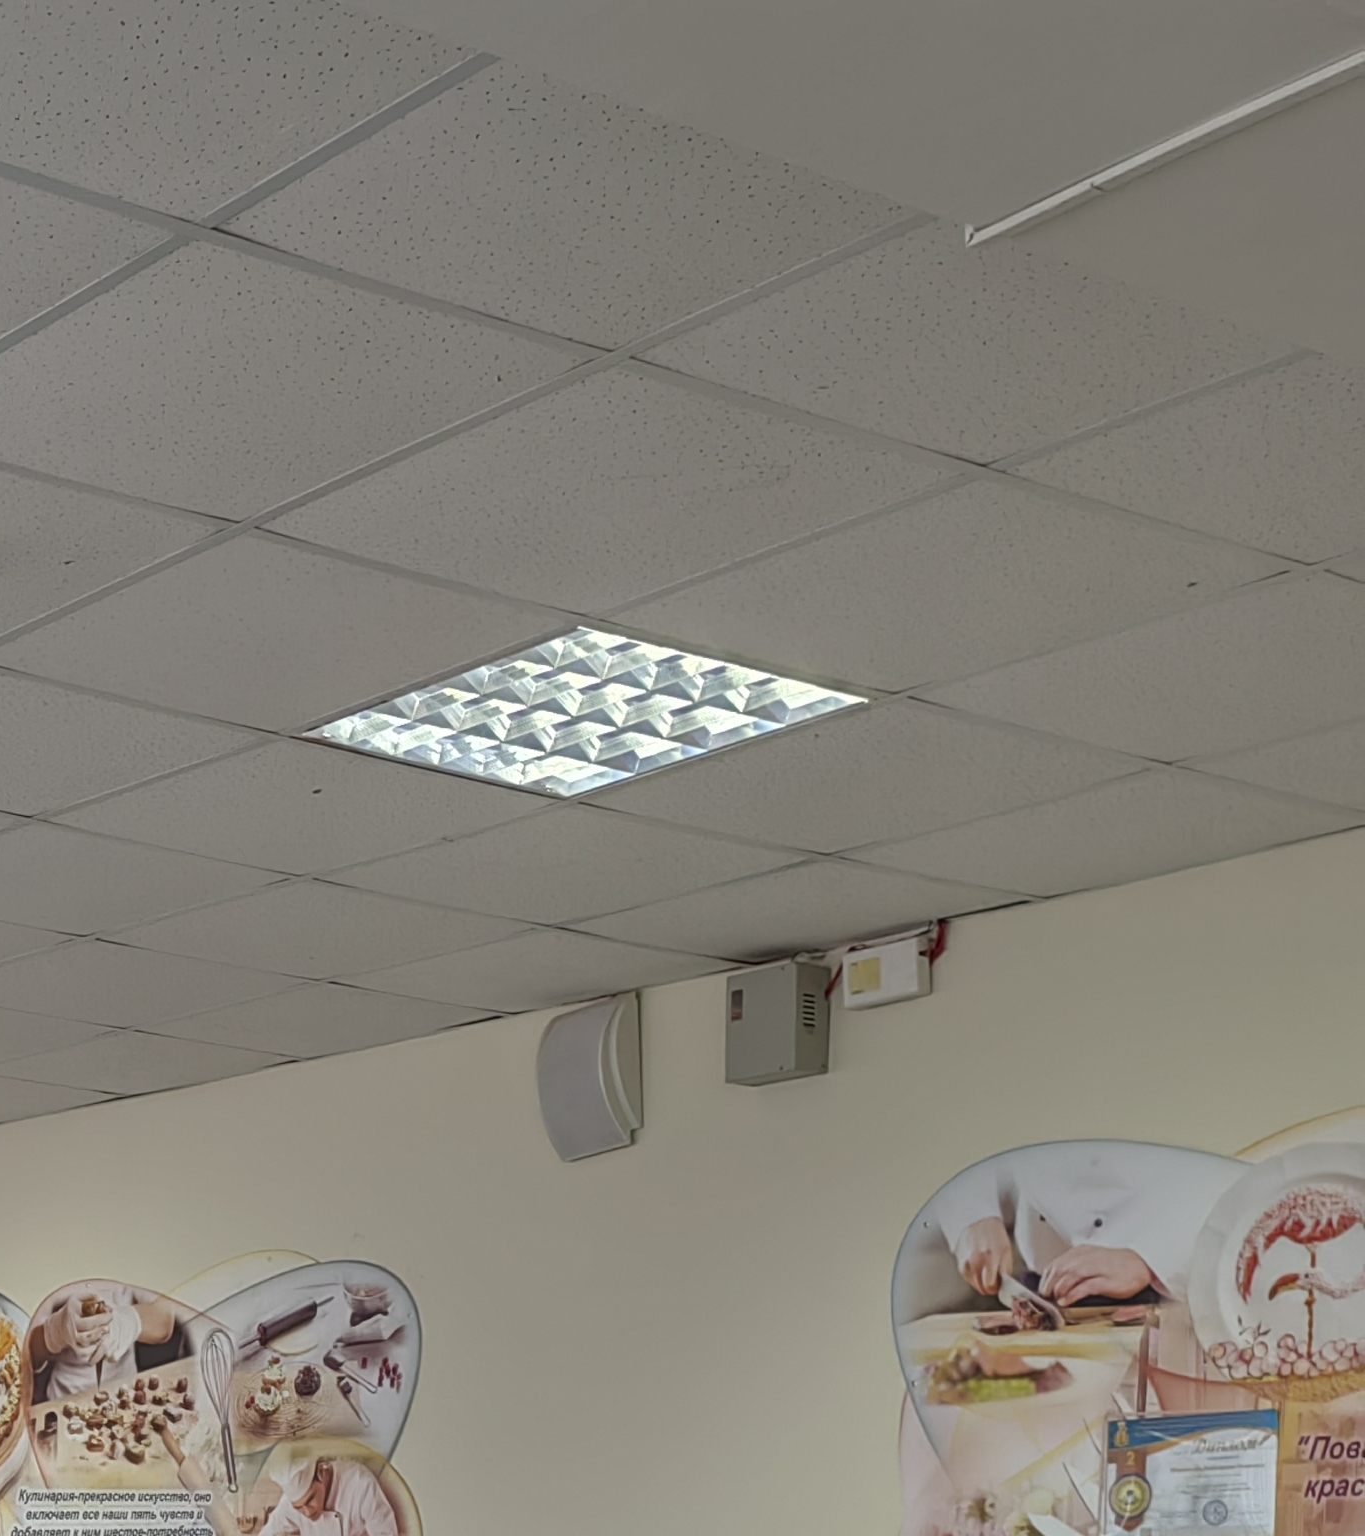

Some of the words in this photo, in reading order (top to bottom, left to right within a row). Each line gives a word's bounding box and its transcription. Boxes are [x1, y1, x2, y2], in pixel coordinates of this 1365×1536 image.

[1298, 1435, 1365, 1460] "Пов
[18, 1489, 136, 1506] Кулинария-прекрасное
[138, 1493, 192, 1505] искусство,
[194, 1494, 212, 1503] оно
[26, 1510, 80, 1521] включает
[82, 1510, 99, 1520] все
[101, 1510, 129, 1520] наши
[130, 1510, 157, 1520] пять
[159, 1511, 195, 1523] чувств
